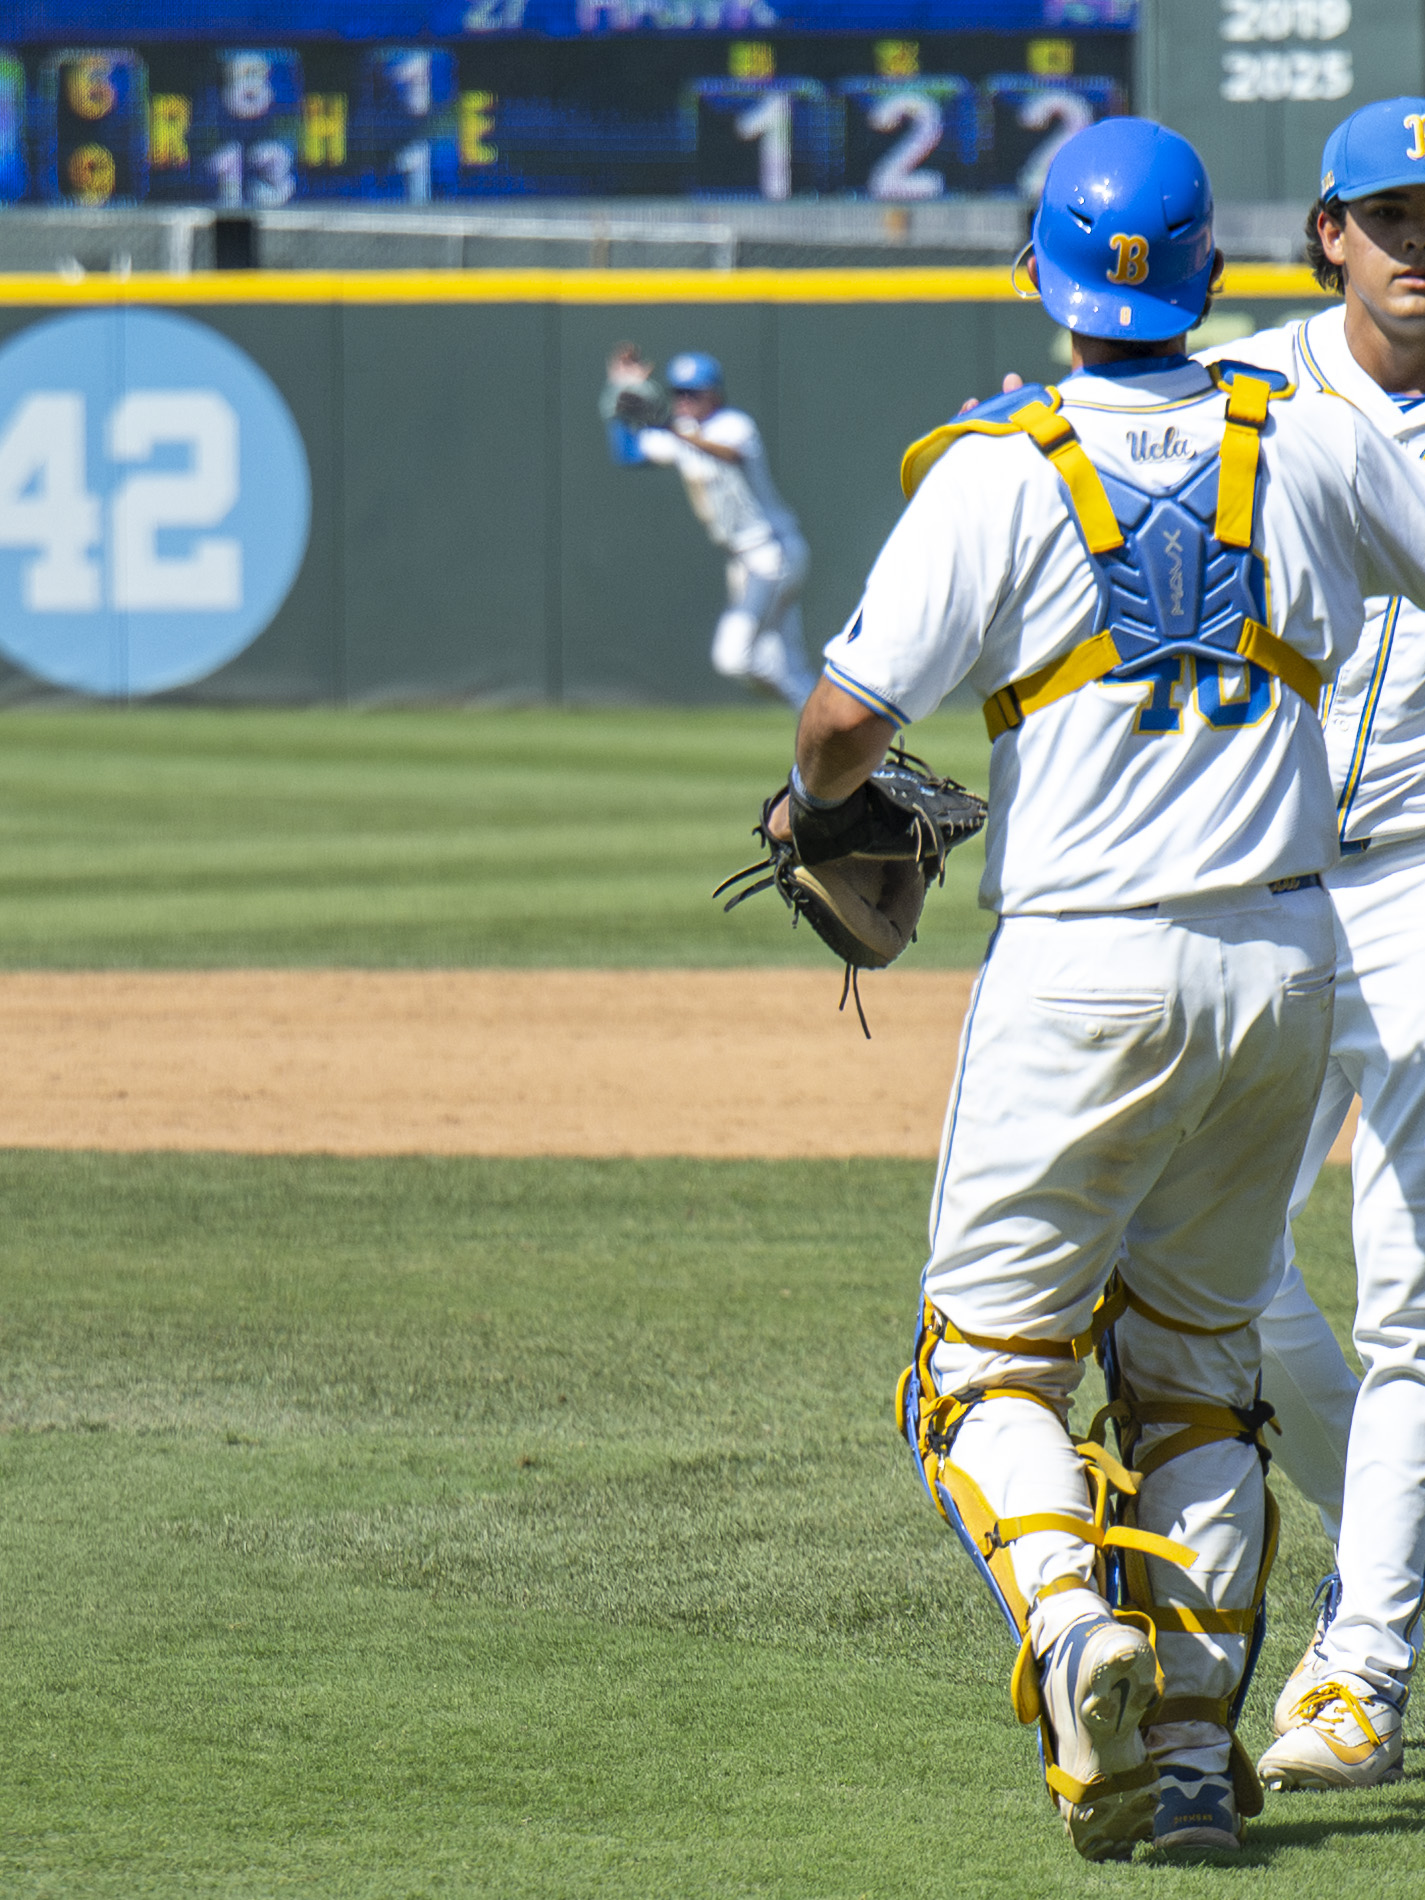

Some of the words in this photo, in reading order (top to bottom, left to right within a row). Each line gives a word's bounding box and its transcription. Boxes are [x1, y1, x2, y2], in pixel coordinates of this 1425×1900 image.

[393, 53, 431, 116] 1
[149, 92, 191, 167] R
[306, 93, 347, 165] H
[458, 91, 498, 165] E
[735, 93, 792, 199] 1
[868, 93, 945, 199] 2
[209, 141, 296, 208] 13
[394, 141, 432, 205] 1
[1106, 233, 1150, 285] B
[0, 389, 243, 613] 42
